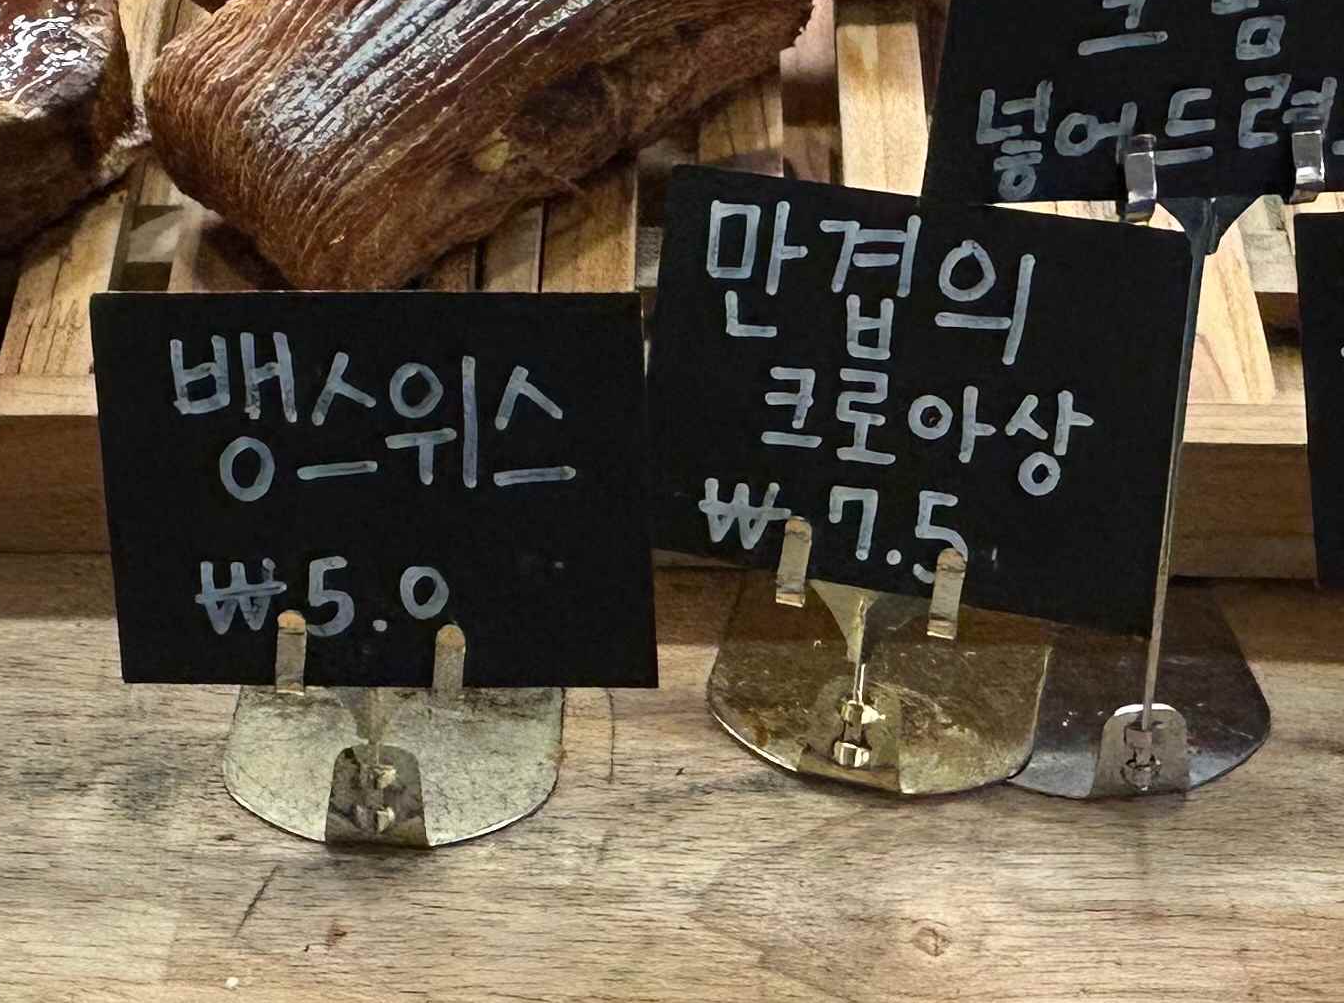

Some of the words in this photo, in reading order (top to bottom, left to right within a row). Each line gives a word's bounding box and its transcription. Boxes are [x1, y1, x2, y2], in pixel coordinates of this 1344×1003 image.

[706, 199, 1036, 365] 만겹의
[169, 331, 577, 501] 뱅스위스
[761, 367, 1095, 495] 크로아상
